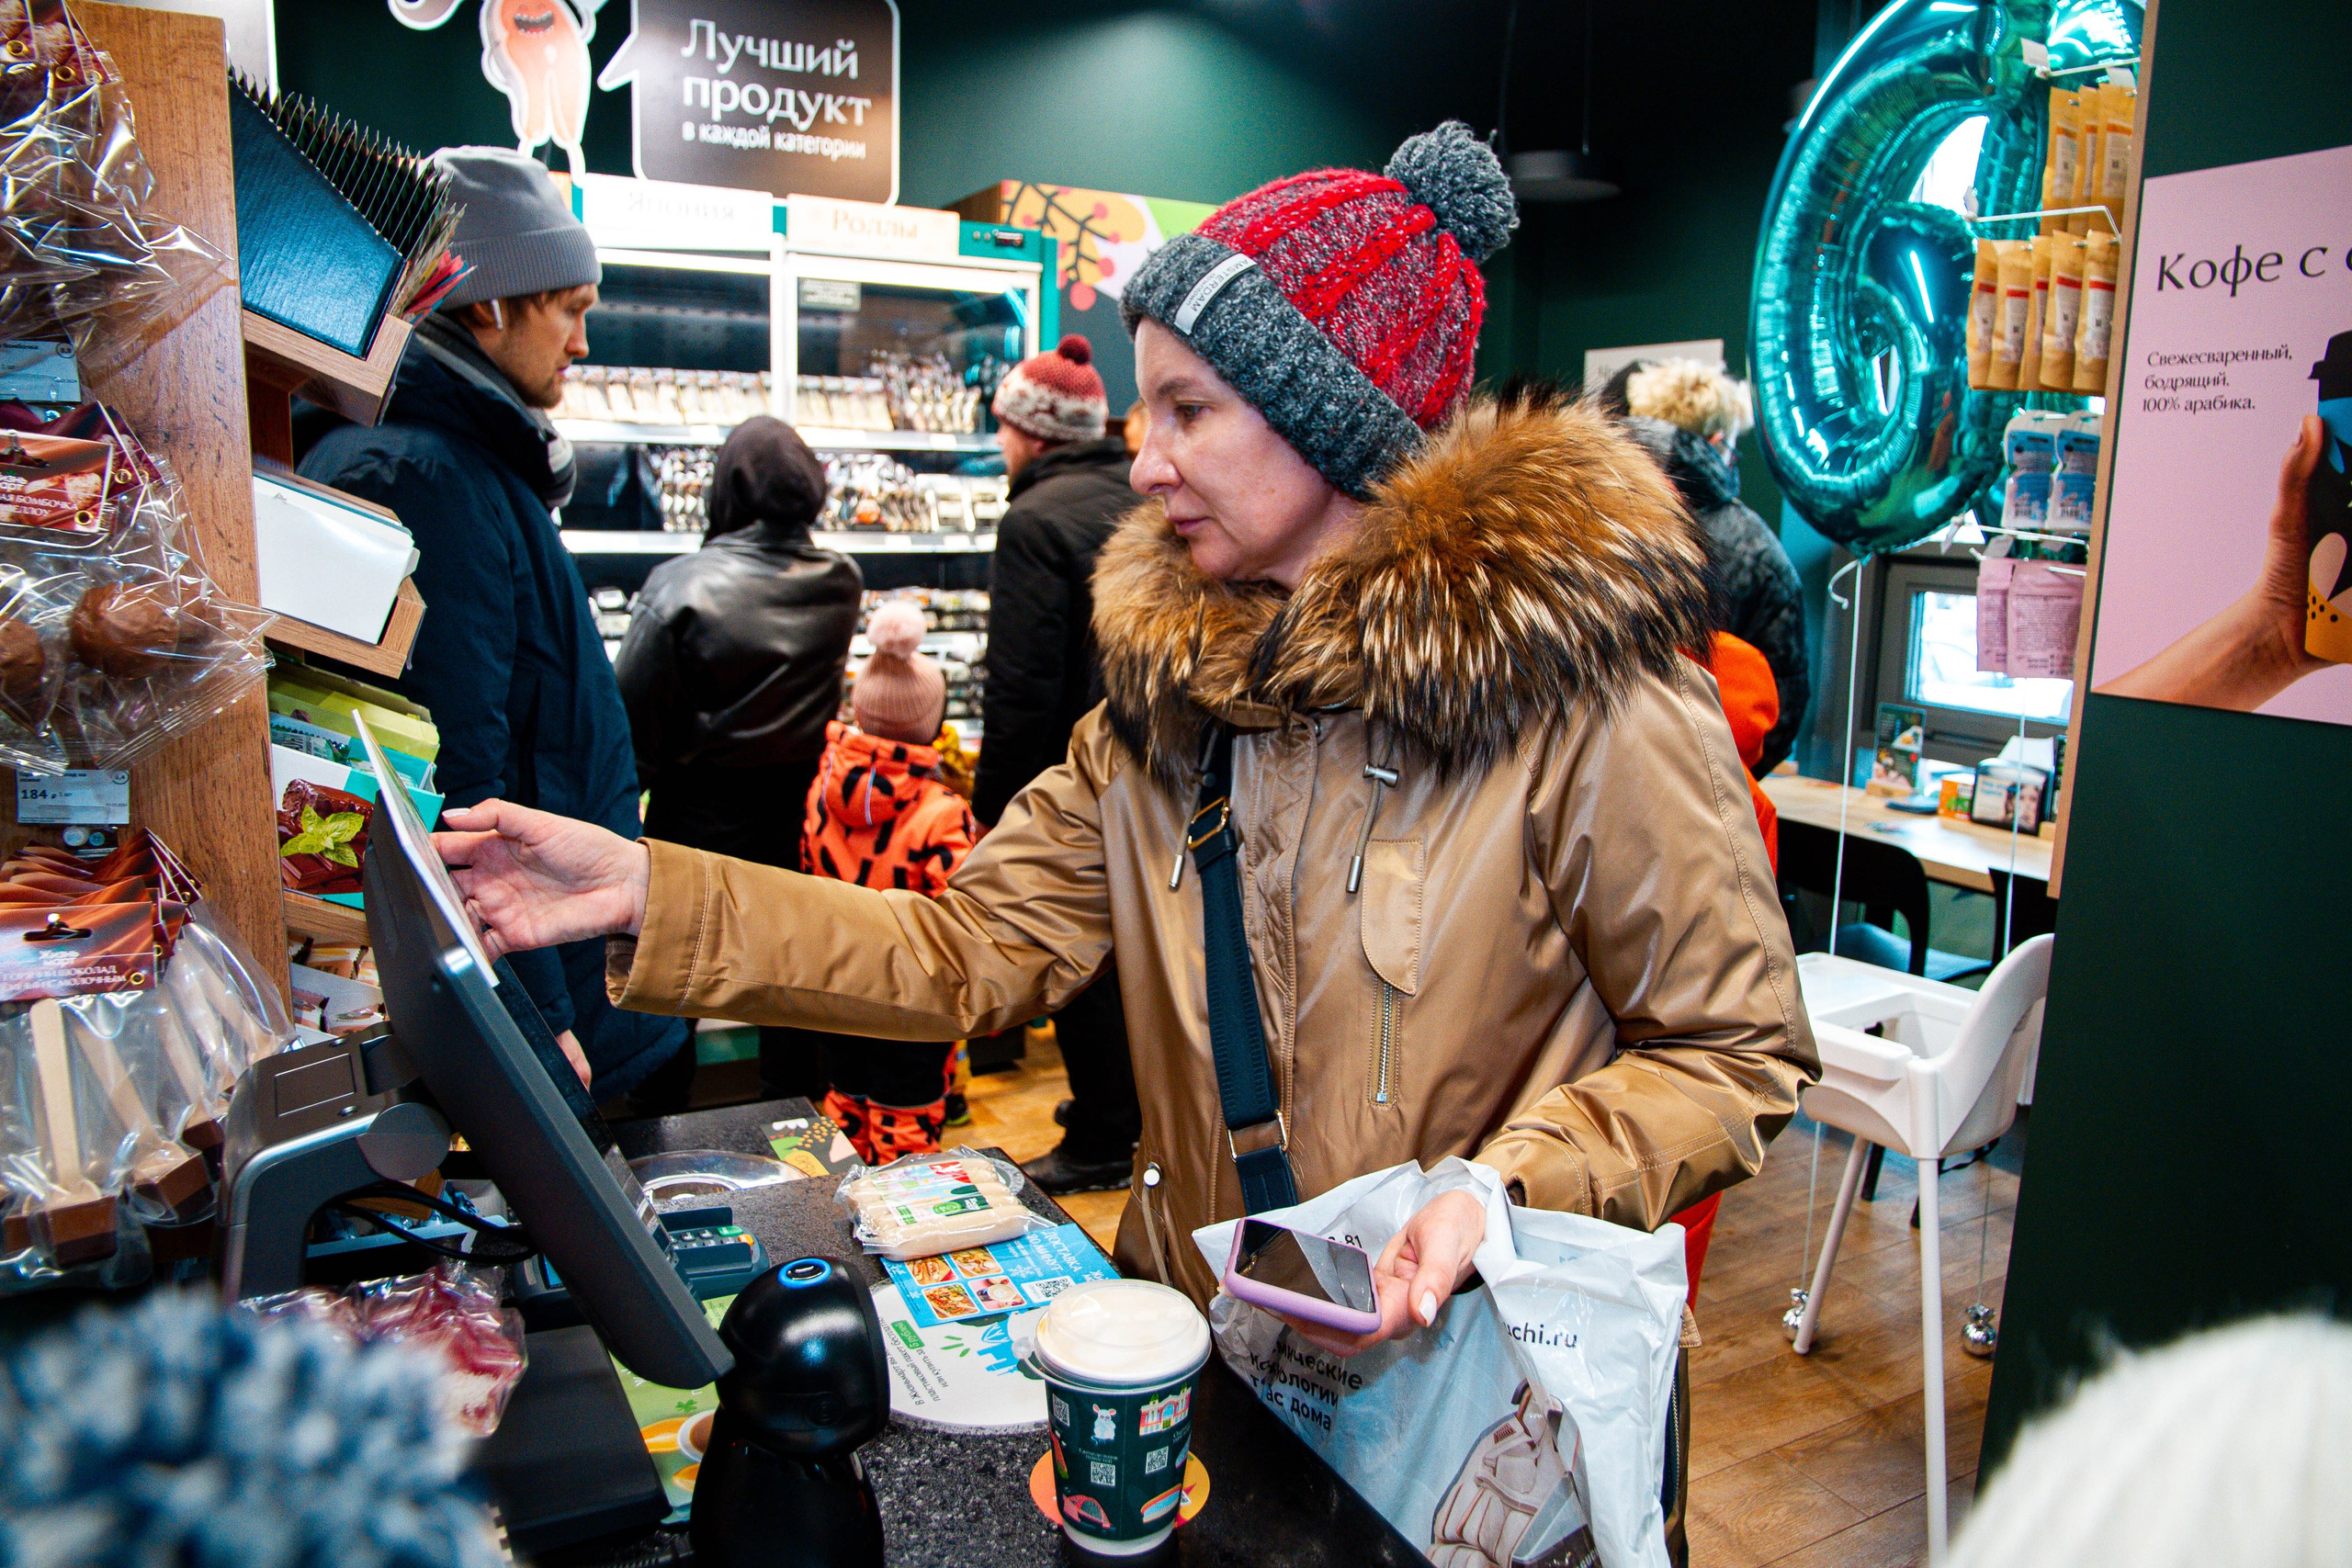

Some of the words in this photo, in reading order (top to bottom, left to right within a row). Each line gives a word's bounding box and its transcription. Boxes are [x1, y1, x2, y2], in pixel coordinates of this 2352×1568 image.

[681, 18, 859, 79] Лучший
[683, 76, 872, 131] продукт
[682, 121, 696, 141] в
[699, 124, 772, 150] каждой
[774, 131, 866, 162] категории
[832, 208, 918, 240] Роллы
[2156, 243, 2284, 298] Кофе
[2299, 245, 2329, 278] с
[1190, 258, 1250, 312] AMSTERDAM
[2146, 343, 2293, 367] Свежесваренный,
[2142, 396, 2181, 412] 100%
[2183, 394, 2256, 414] арабика.
[15, 493, 80, 511] БОМБОЧКА
[20, 789, 49, 800] 184
[57, 964, 118, 978] ШОКОЛАД
[1033, 1244, 1064, 1270] МИНУТ
[1040, 1229, 1082, 1272] ДОСТАВКА
[876, 1315, 901, 1345] бесплатно
[894, 1321, 919, 1343] рублей
[895, 1345, 913, 1363] пакет
[915, 1348, 926, 1356] за
[920, 1354, 941, 1376] купить
[890, 1363, 921, 1399] Жизньмарт
[906, 1362, 941, 1402] пластиковый
[934, 1374, 948, 1388] или
[1290, 1397, 1332, 1431] дома
